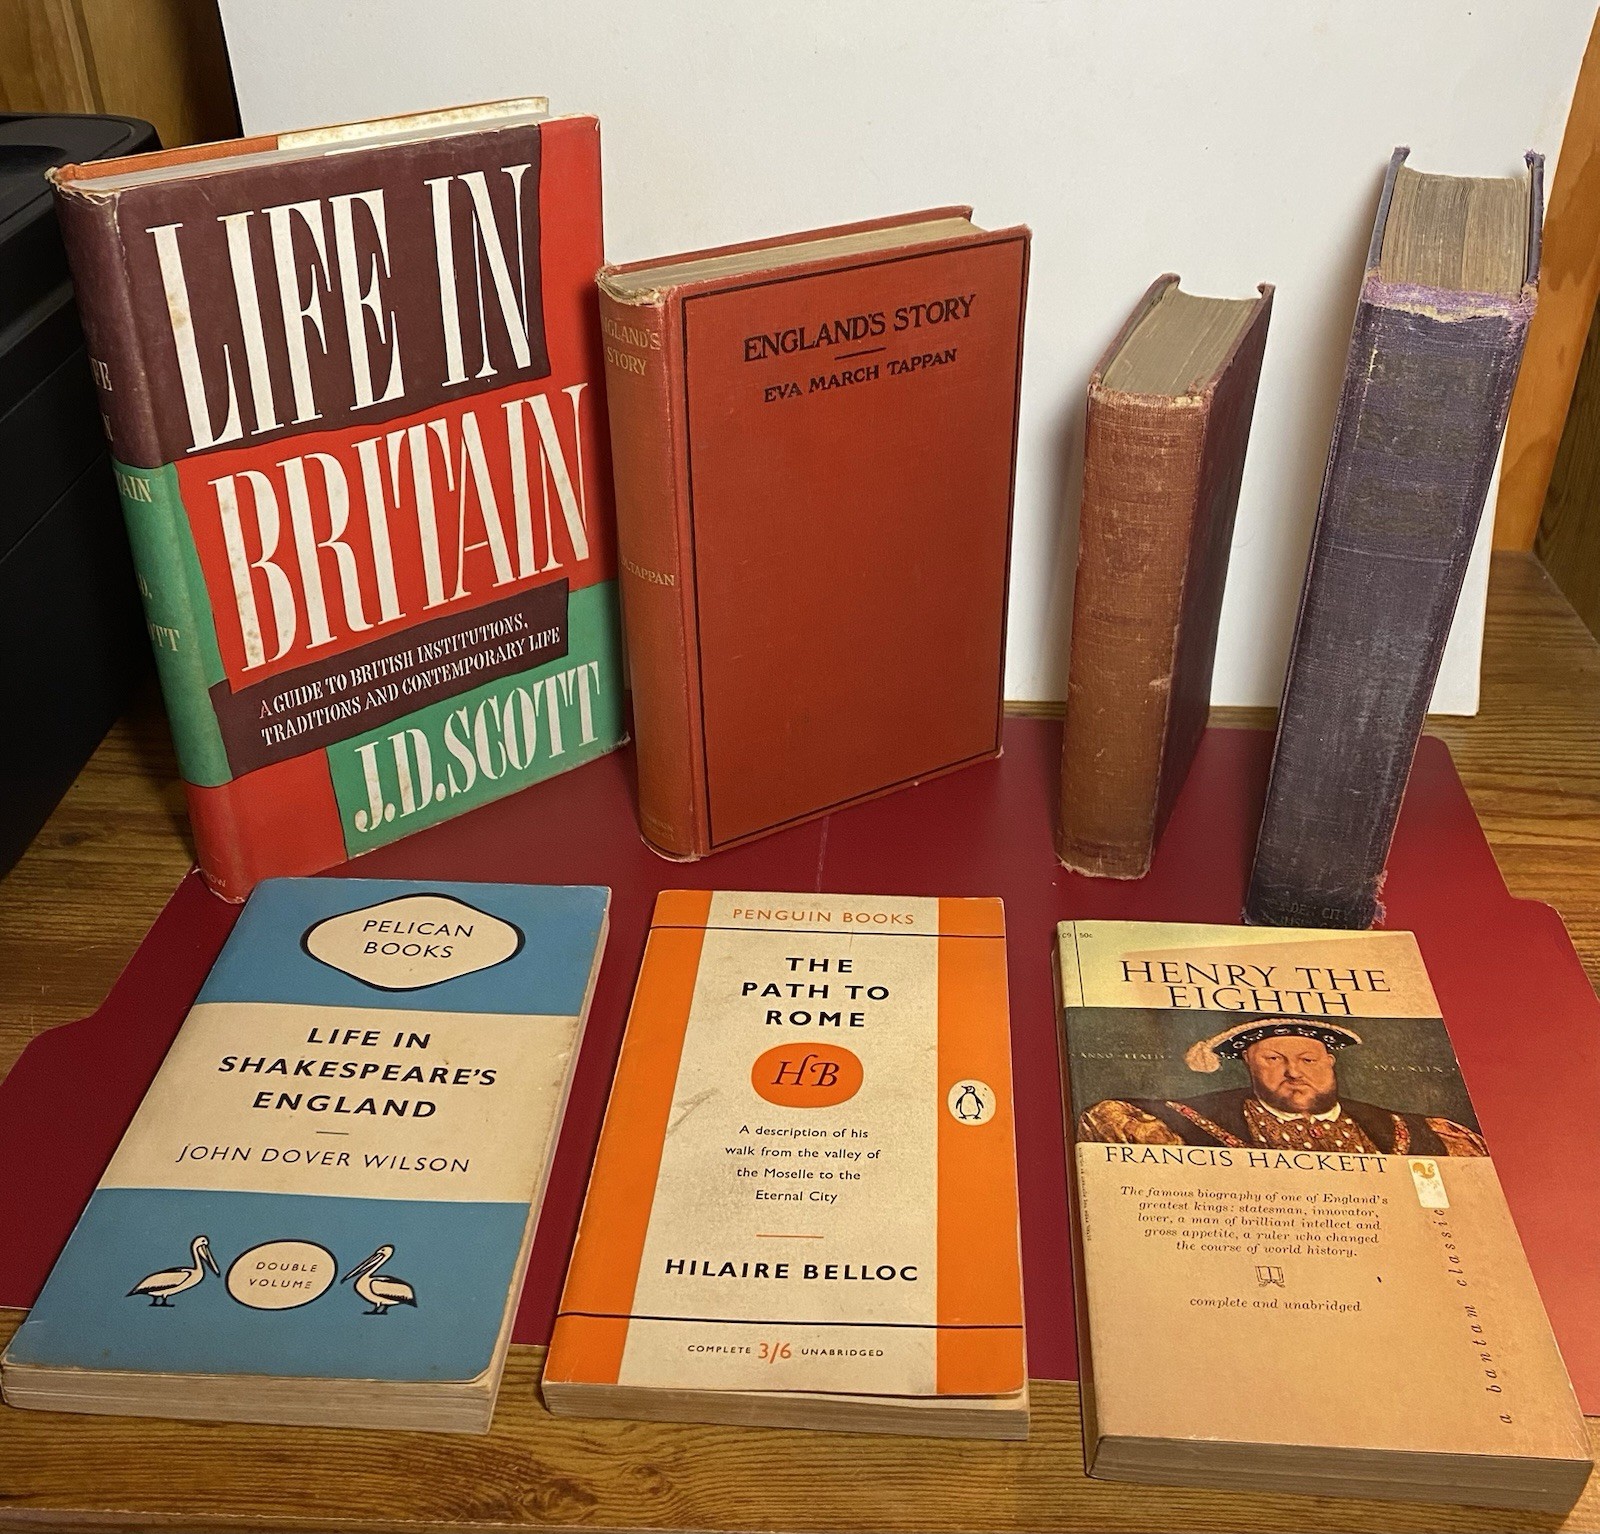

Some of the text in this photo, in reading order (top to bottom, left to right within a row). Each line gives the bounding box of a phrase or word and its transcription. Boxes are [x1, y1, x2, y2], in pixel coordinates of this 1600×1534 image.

[145, 163, 532, 454] LIFE IN
[602, 317, 661, 350] NGLAND'S
[743, 293, 977, 363] ENGLAND'S STORY
[607, 346, 647, 376] STORY
[764, 348, 958, 403] EVA MARCH TAPPAN
[207, 382, 590, 672] BRITAIN
[259, 613, 529, 719] A GUIDE TO BRITISH INSTITUTIONS,
[261, 627, 560, 747] TRADITIONS AND CONTEMPORARY LIFE
[733, 908, 914, 925] PENGUIN BOOKS
[362, 919, 475, 938] PELICAN
[363, 941, 454, 960] BOOKS
[786, 957, 853, 973] THE
[1119, 960, 1391, 992] HENRY THE
[741, 982, 890, 1001] PATH TO
[1169, 985, 1354, 1015] EIGHTH
[765, 1010, 865, 1027] ROME
[306, 1027, 431, 1049] LIFE IN
[217, 1056, 497, 1087] SHAKESPEARE'S
[771, 1054, 840, 1087] HB
[252, 1092, 437, 1118] ENGLAND
[739, 1125, 869, 1138] A description of his
[175, 1144, 471, 1173] JOHN DOVER WILSON
[725, 1146, 881, 1161] walk from the valley of
[1105, 1145, 1388, 1174] FRANCIS HACKETT
[737, 1168, 861, 1180] the Moselle to the
[755, 1190, 838, 1204] Eternal City
[1120, 1186, 1144, 1196] The
[1146, 1187, 1194, 1198] famous
[1197, 1189, 1261, 1201] biography
[1265, 1192, 1278, 1203] of
[1306, 1193, 1319, 1204] of
[1322, 1193, 1388, 1205] England's
[1139, 1201, 1189, 1211] greatest
[1239, 1204, 1307, 1216] statesman,
[1313, 1205, 1379, 1218] innovator,
[1138, 1213, 1173, 1224] lover,
[1224, 1216, 1238, 1227] of
[1241, 1216, 1295, 1227] brilliant
[1302, 1219, 1351, 1229] intellect
[1356, 1220, 1381, 1230] and
[1144, 1229, 1178, 1237] gross
[1182, 1228, 1239, 1240] appetite,
[1256, 1230, 1290, 1240] ruler
[1296, 1232, 1321, 1241] who
[1326, 1232, 1379, 1244] changed
[1176, 1241, 1357, 1258] the course of world history.
[256, 1261, 317, 1272] DOUBLE
[665, 1259, 918, 1281] HILAIRE BELLOC
[249, 1278, 312, 1289] VOLUME
[1190, 1297, 1362, 1313] complete and unabridged
[687, 1343, 884, 1364] COMPLETE 3/6 UNABRIDGED
[1464, 1304, 1502, 1394] bantam
[1500, 1412, 1513, 1425] a
